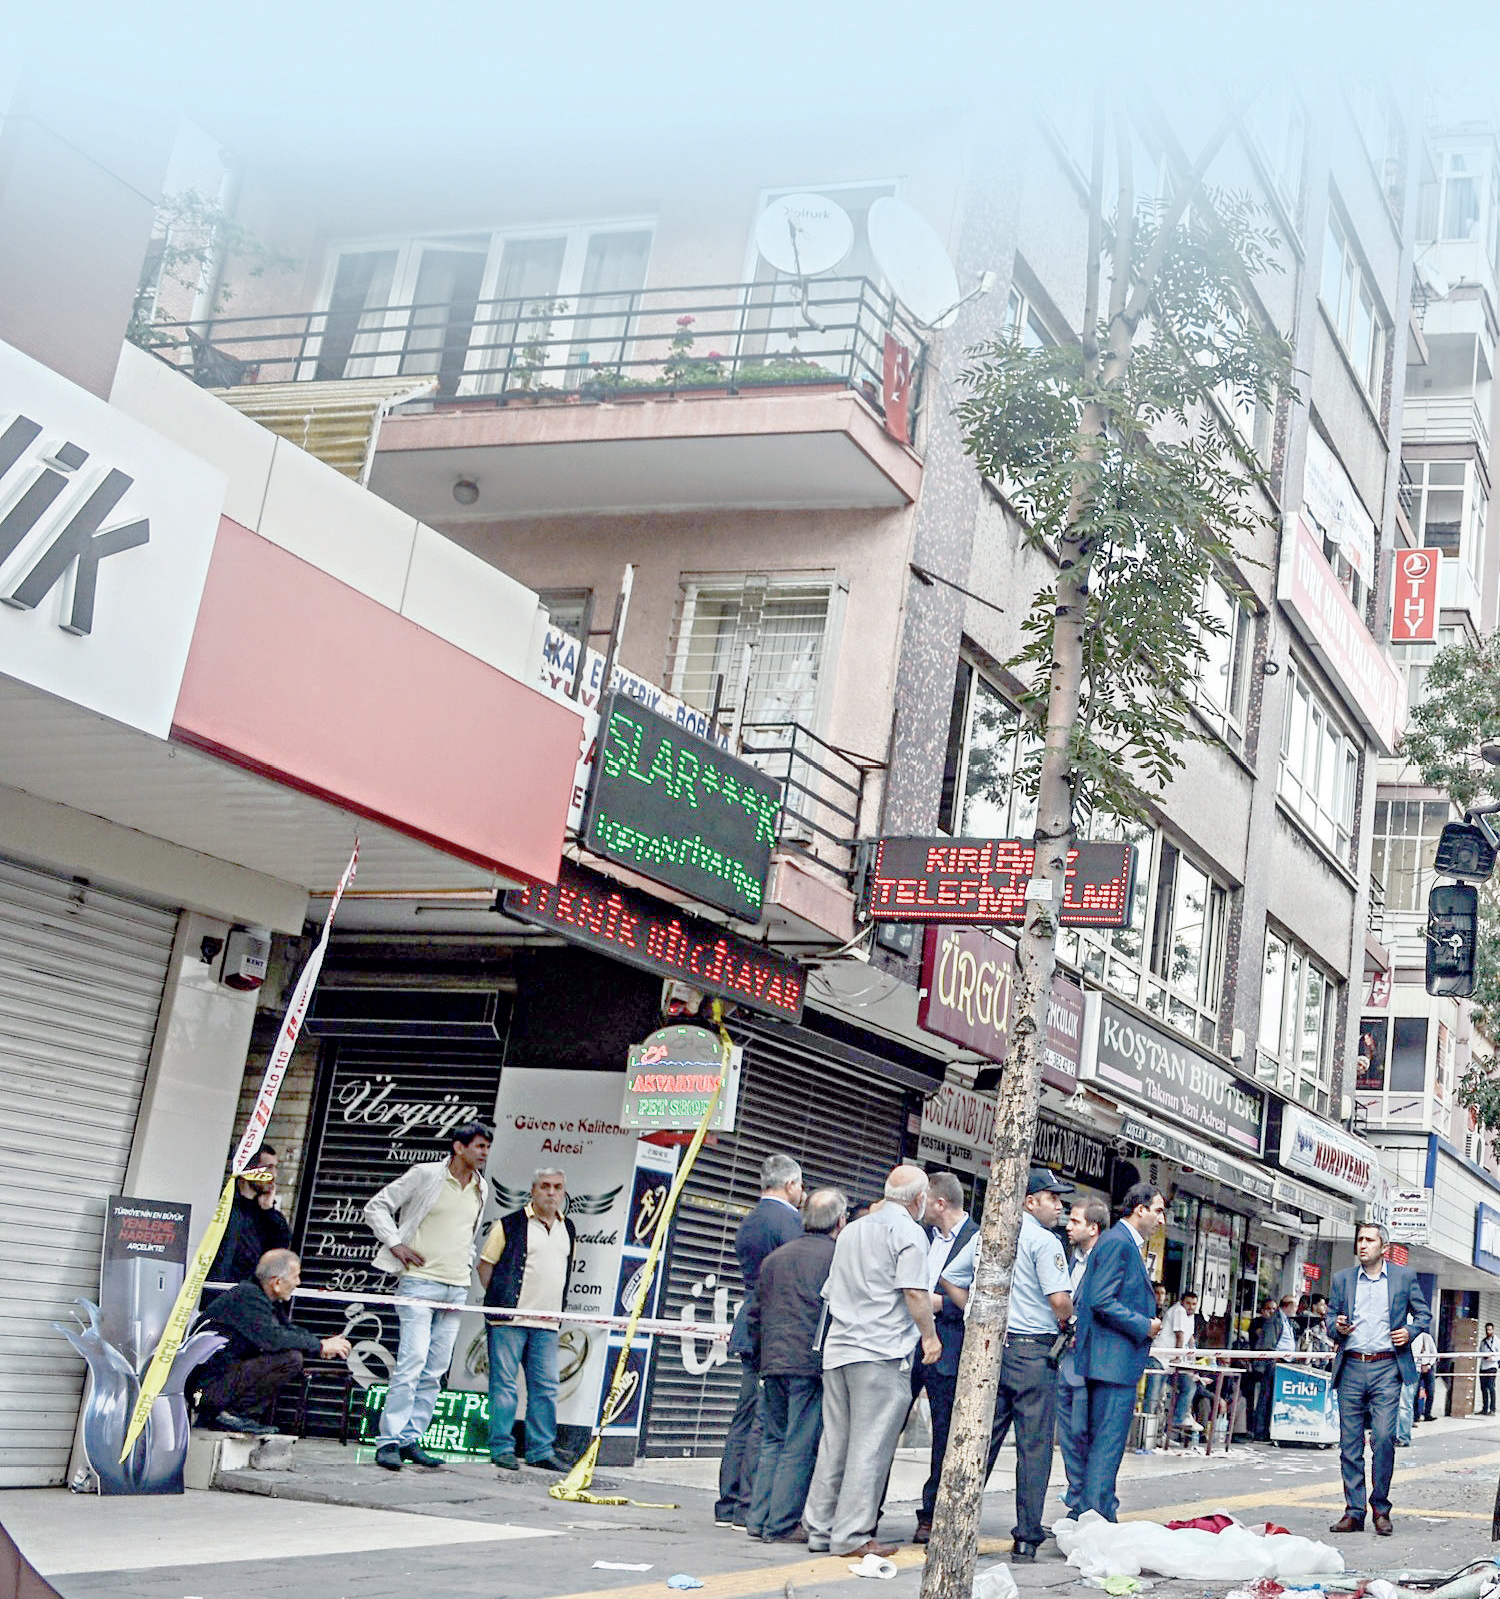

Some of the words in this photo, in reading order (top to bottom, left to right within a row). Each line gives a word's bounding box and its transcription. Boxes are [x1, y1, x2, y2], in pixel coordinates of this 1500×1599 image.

[1403, 579, 1426, 637] THY
[938, 932, 1014, 1033] ÜRGÜ
[1103, 1016, 1186, 1086] KOŞTAN
[1189, 1063, 1262, 1125] BİJUTERİ
[338, 1075, 485, 1138] Ürgüp
[638, 1098, 668, 1116] PET
[1145, 1077, 1179, 1111] Takının
[1181, 1095, 1199, 1121] Yeni
[1199, 1109, 1227, 1135] Adresi
[560, 1121, 574, 1133] ve
[541, 1138, 584, 1155] Adresi
[162, 1212, 184, 1221] BÜYÜK
[568, 1282, 602, 1296] .com
[1282, 1381, 1318, 1396] Erikli
